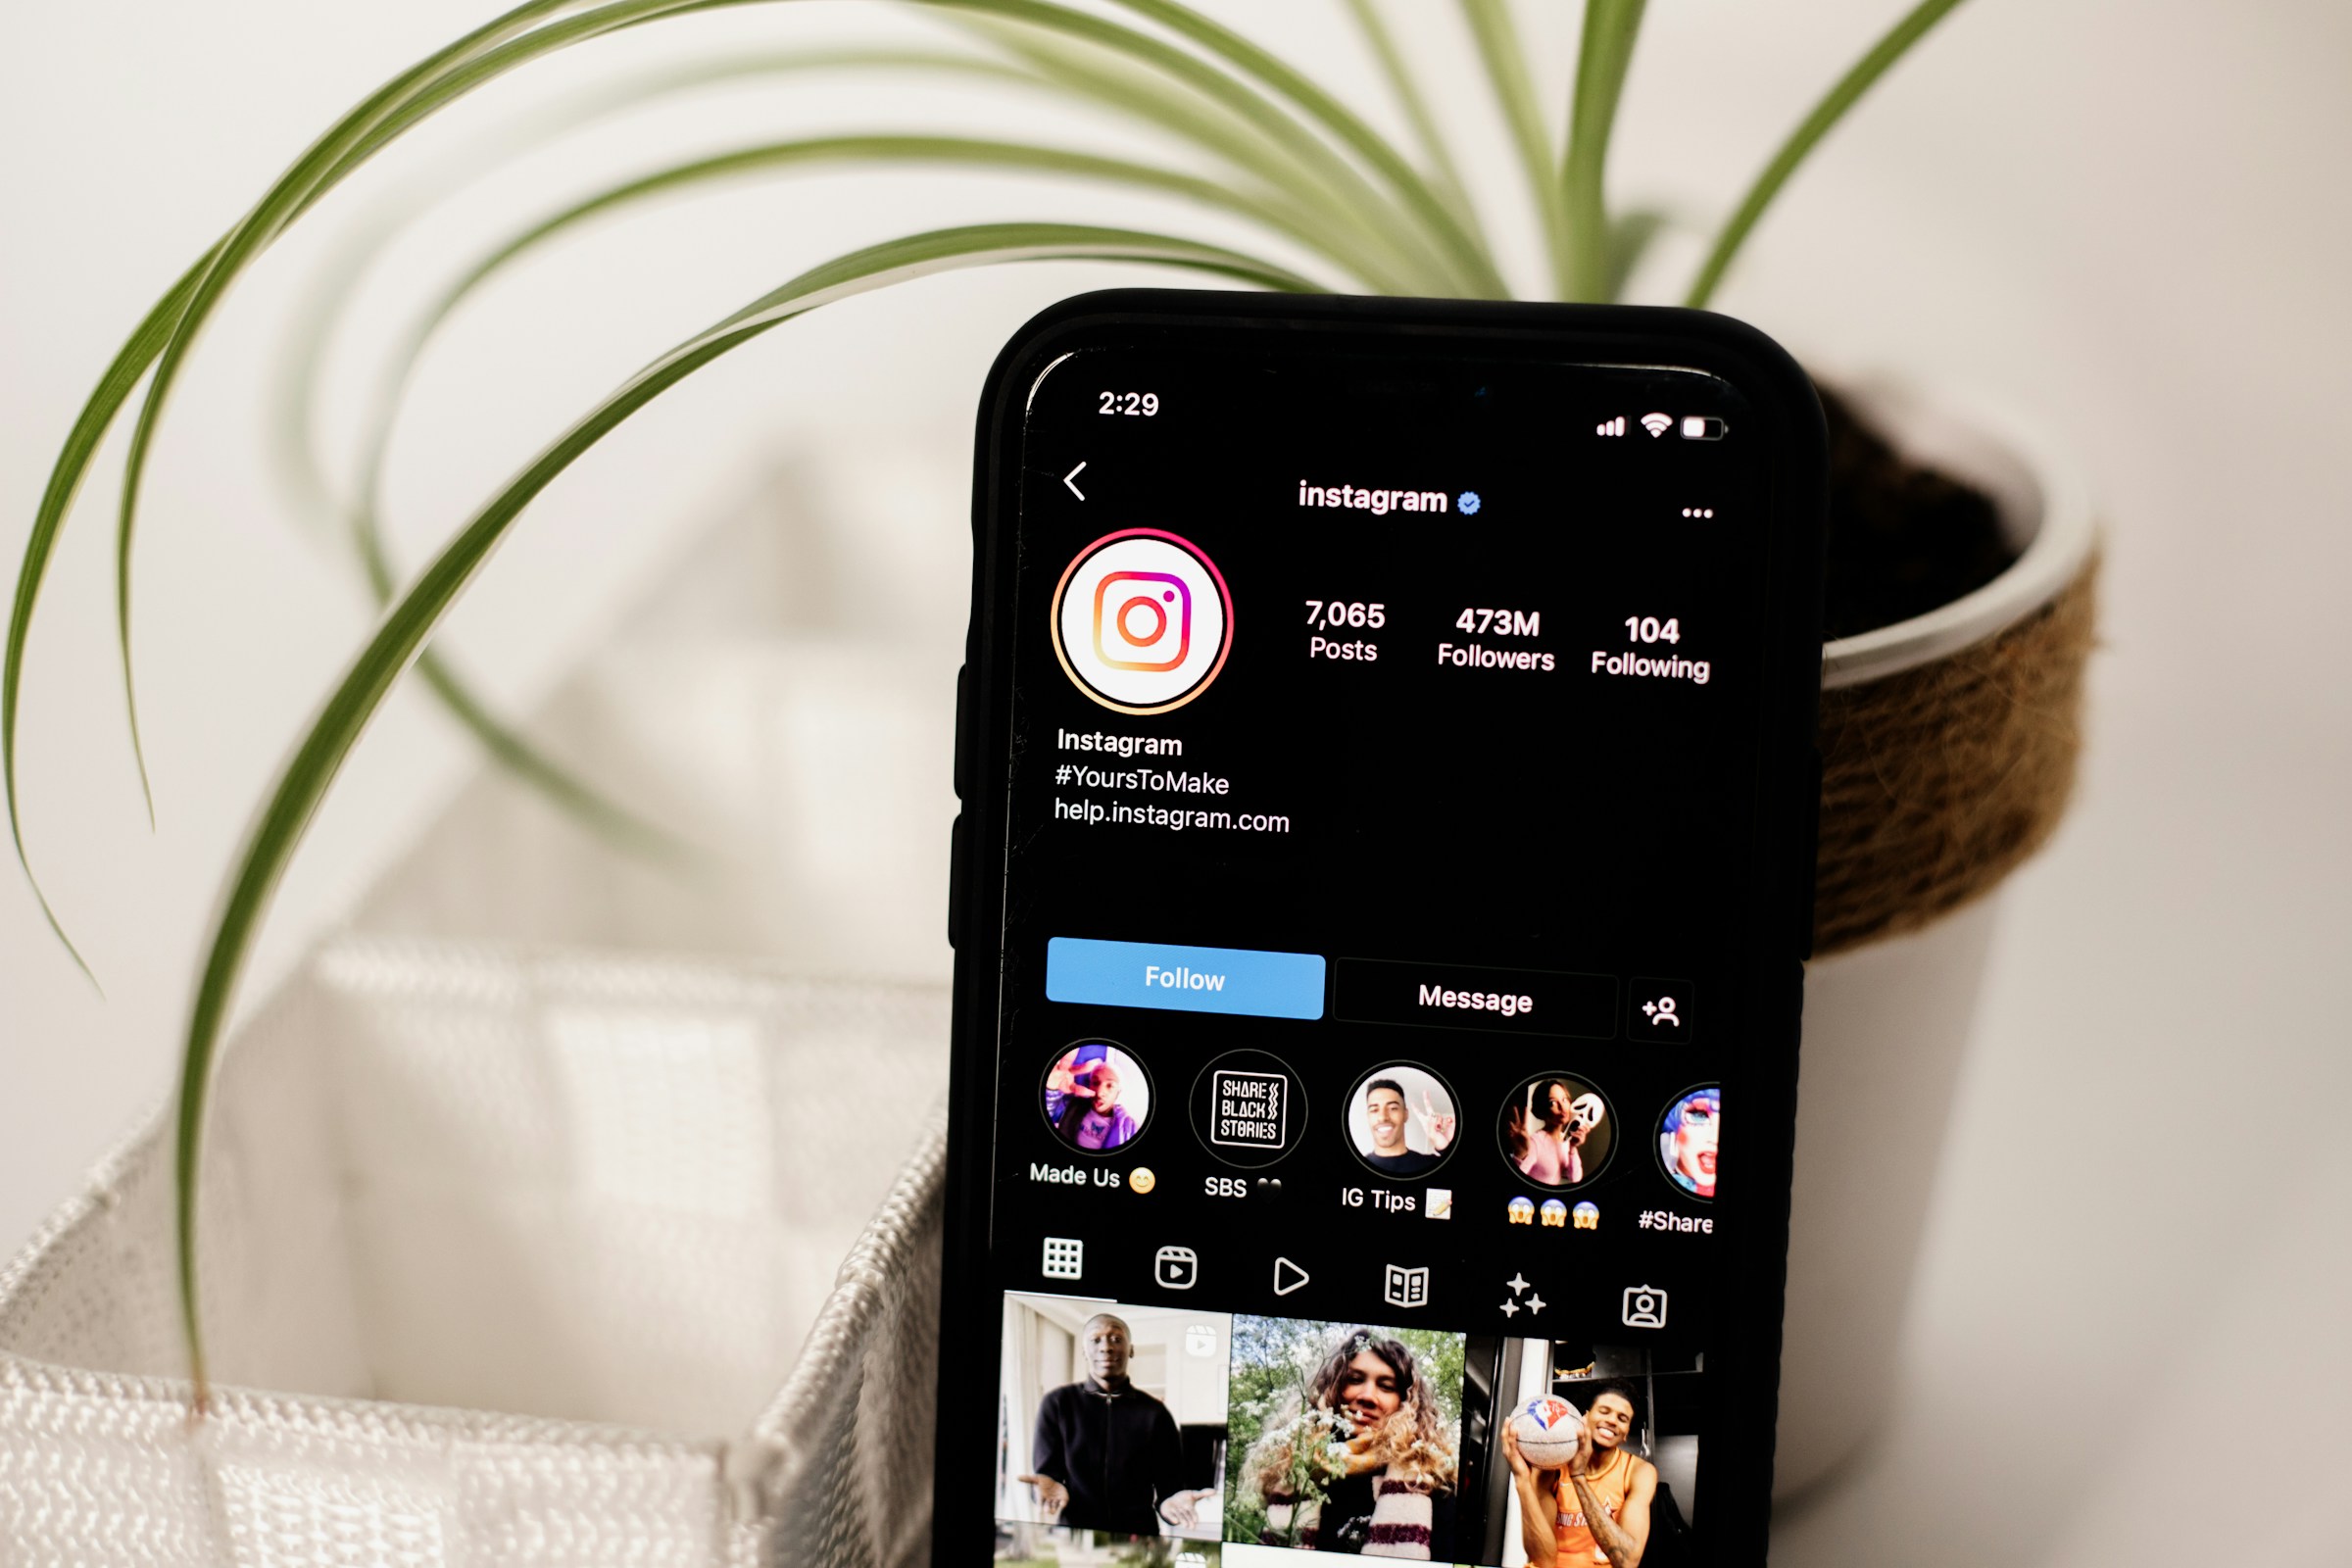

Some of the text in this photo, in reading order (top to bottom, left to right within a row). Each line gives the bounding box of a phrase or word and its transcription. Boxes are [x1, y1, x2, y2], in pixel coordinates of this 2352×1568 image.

[1099, 391, 1159, 416] 2:29
[1298, 479, 1448, 515] instagram
[1304, 600, 1386, 631] 7,065
[1455, 608, 1541, 637] 473M
[1624, 615, 1681, 645] 104
[1309, 636, 1378, 662] Posts
[1438, 642, 1555, 671] Followers
[1591, 650, 1711, 685] Following
[1057, 728, 1183, 758] Instagram
[1054, 764, 1230, 795] #YoursToMake
[1054, 797, 1290, 833] help.instagram.com
[1145, 965, 1225, 992] Follow
[1418, 984, 1534, 1017] Message
[1222, 1080, 1267, 1100] SHARE
[1221, 1100, 1266, 1119] BLACK
[1220, 1119, 1277, 1140] STORIES
[1029, 1162, 1121, 1189] Made Us
[1204, 1176, 1248, 1199] SBS
[1342, 1187, 1416, 1214] IG Tips
[1638, 1209, 1714, 1235] #Share
